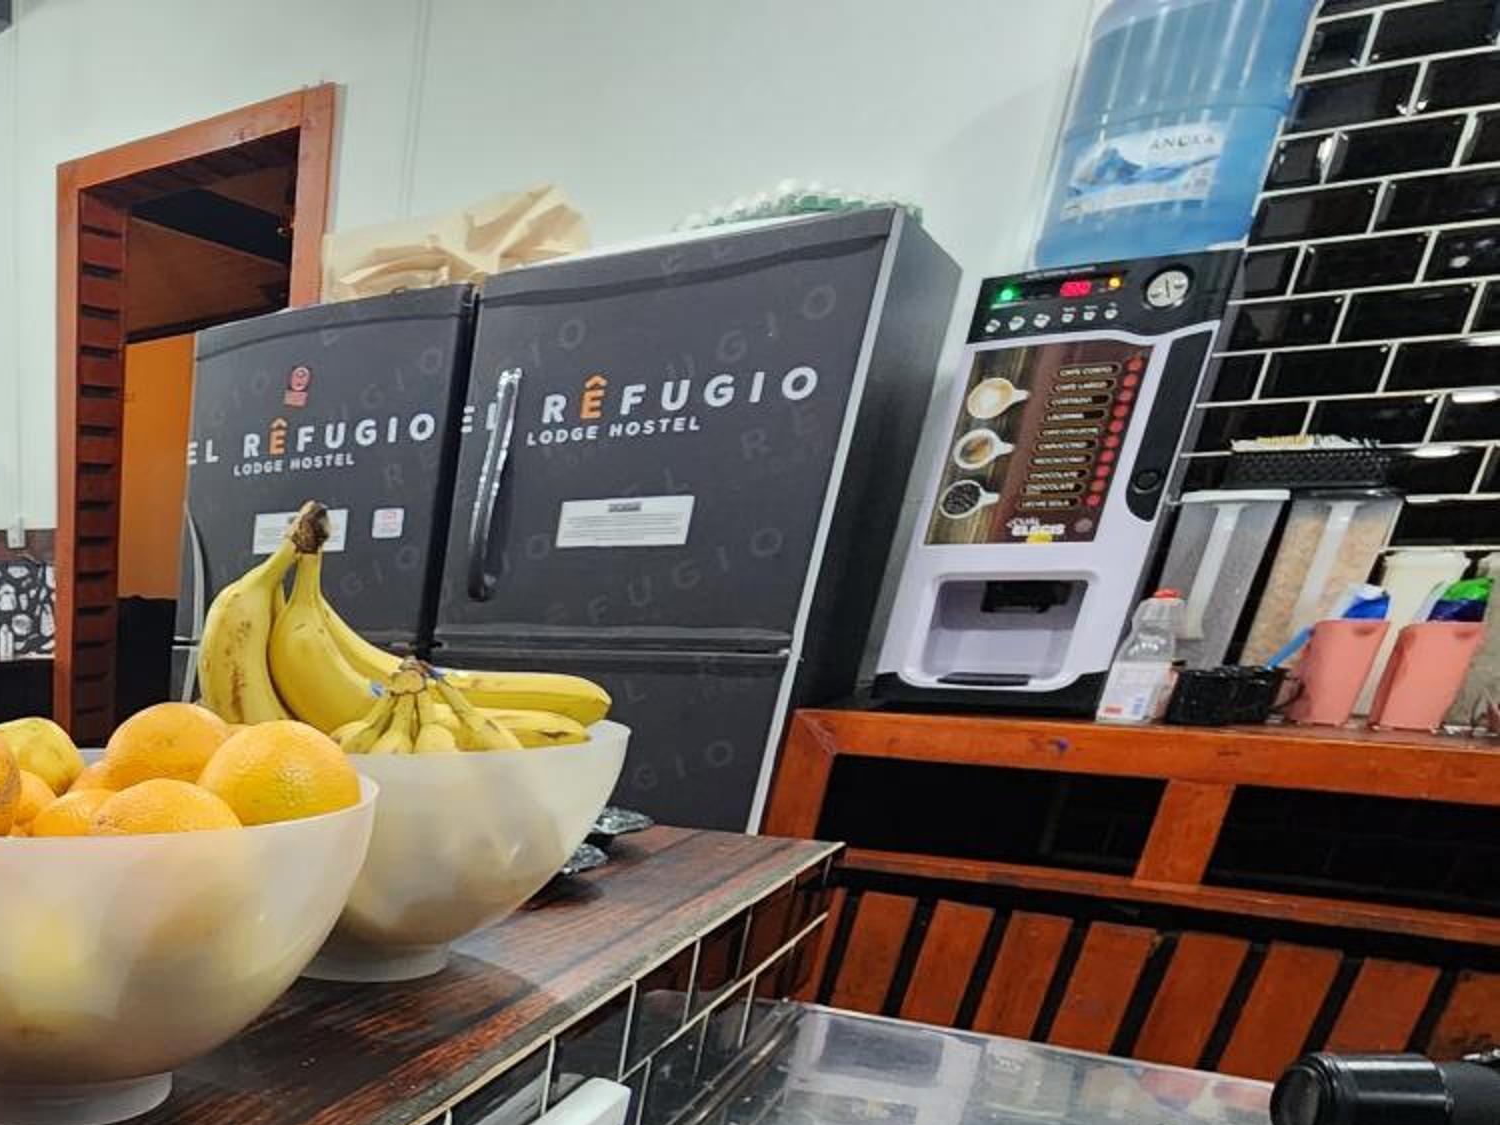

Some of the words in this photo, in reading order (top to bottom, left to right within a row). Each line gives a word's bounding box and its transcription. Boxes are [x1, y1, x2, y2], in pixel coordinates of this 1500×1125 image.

[526, 426, 598, 447] LODGE
[608, 414, 701, 438] HOSTEL
[187, 437, 220, 466] EL
[232, 458, 284, 478] LODGE
[289, 452, 356, 472] HOSTEL
